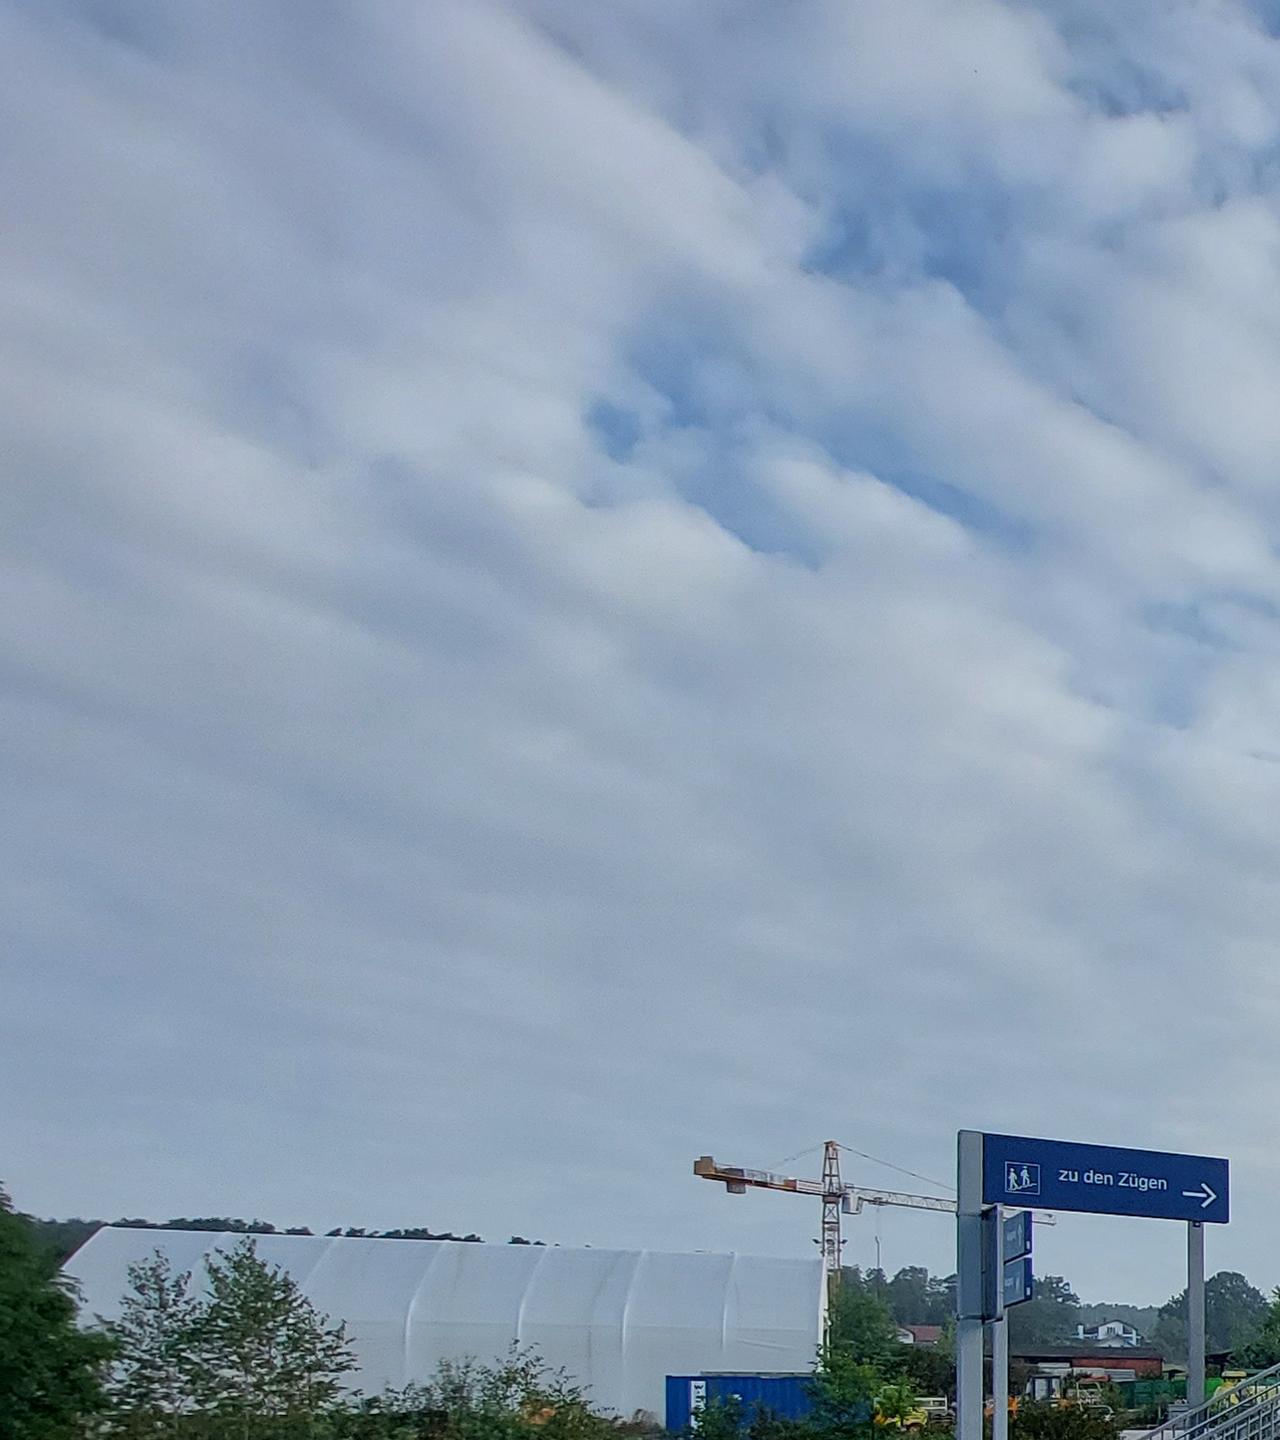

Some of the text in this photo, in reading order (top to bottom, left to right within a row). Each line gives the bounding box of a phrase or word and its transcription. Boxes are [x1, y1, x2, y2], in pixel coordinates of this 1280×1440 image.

[1058, 1169, 1168, 1192] zu den Zügen
